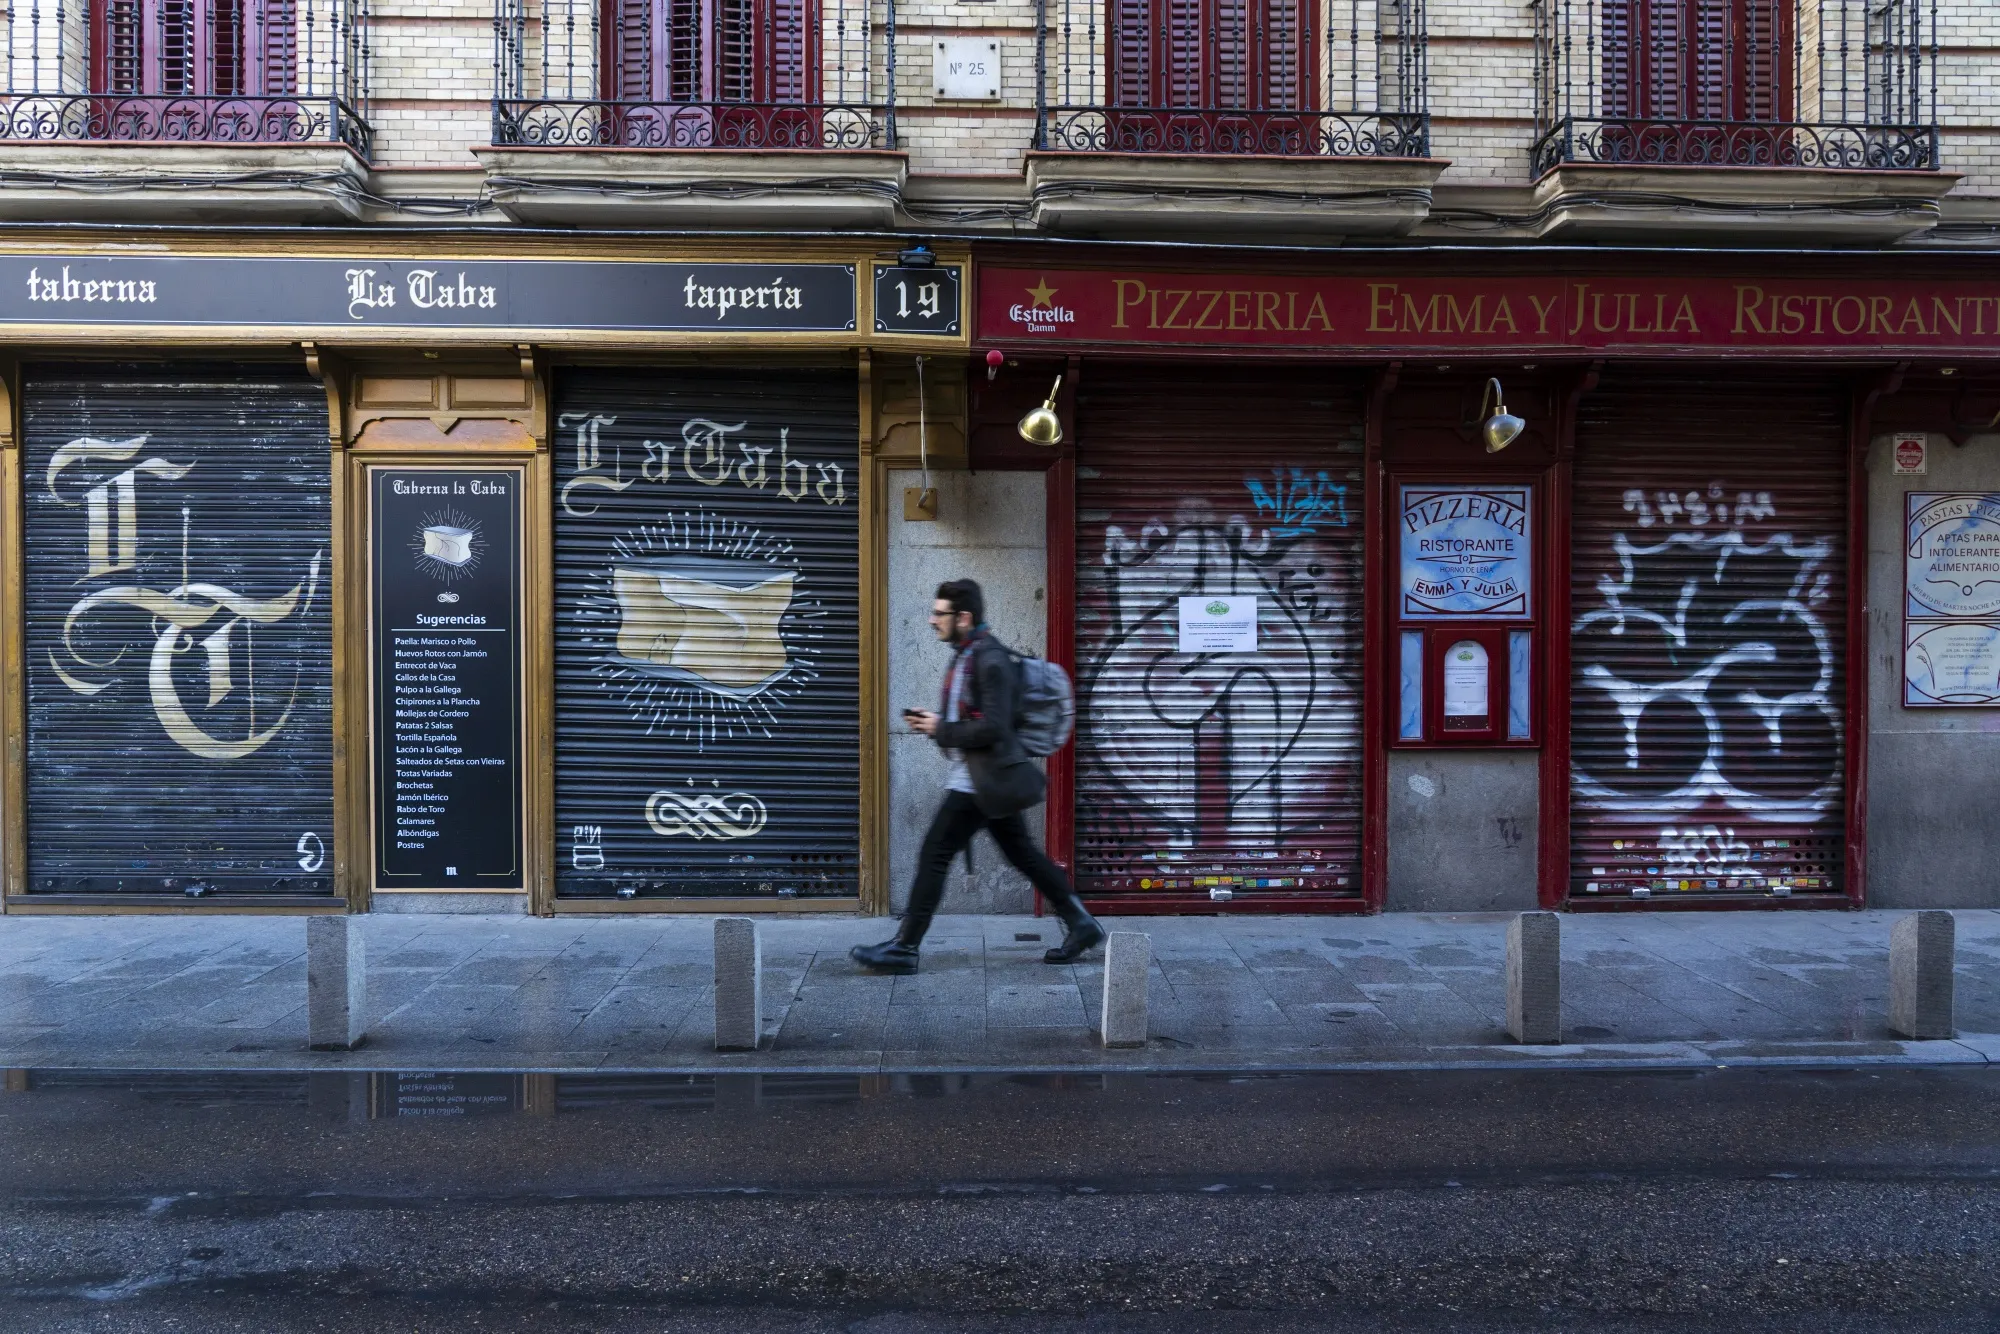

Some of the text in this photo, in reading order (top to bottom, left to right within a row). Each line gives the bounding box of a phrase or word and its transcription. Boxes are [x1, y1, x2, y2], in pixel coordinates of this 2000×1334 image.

[27, 265, 157, 303] taberna
[345, 268, 497, 320] La Taba
[683, 274, 802, 321] tapería
[895, 280, 941, 319] 19
[1009, 304, 1074, 322] Estrella
[1528, 295, 1558, 335] Y
[1027, 323, 1056, 332] Damm
[393, 479, 505, 495] Taberna la Taba
[1404, 497, 1526, 537] PIZZERIA
[1920, 504, 1962, 527] PASTAS
[1966, 504, 1973, 514] Y
[1420, 539, 1514, 552] RISTORANTE
[1937, 534, 2000, 542] APTAS PARA
[1415, 580, 1514, 596] EMMA Y JULIA
[1912, 584, 1933, 602] ABIERTO
[1942, 602, 1967, 610] MARTES
[1968, 602, 1989, 610] NOCHE
[416, 614, 486, 626] Sugerencias
[395, 686, 417, 694] Pulpo
[434, 686, 461, 694] Gallega
[395, 698, 435, 706] Chipirones
[396, 710, 426, 718] Mollejas
[424, 734, 456, 742] Española
[434, 746, 462, 754] Gallega
[397, 830, 439, 838] Albóndigas
